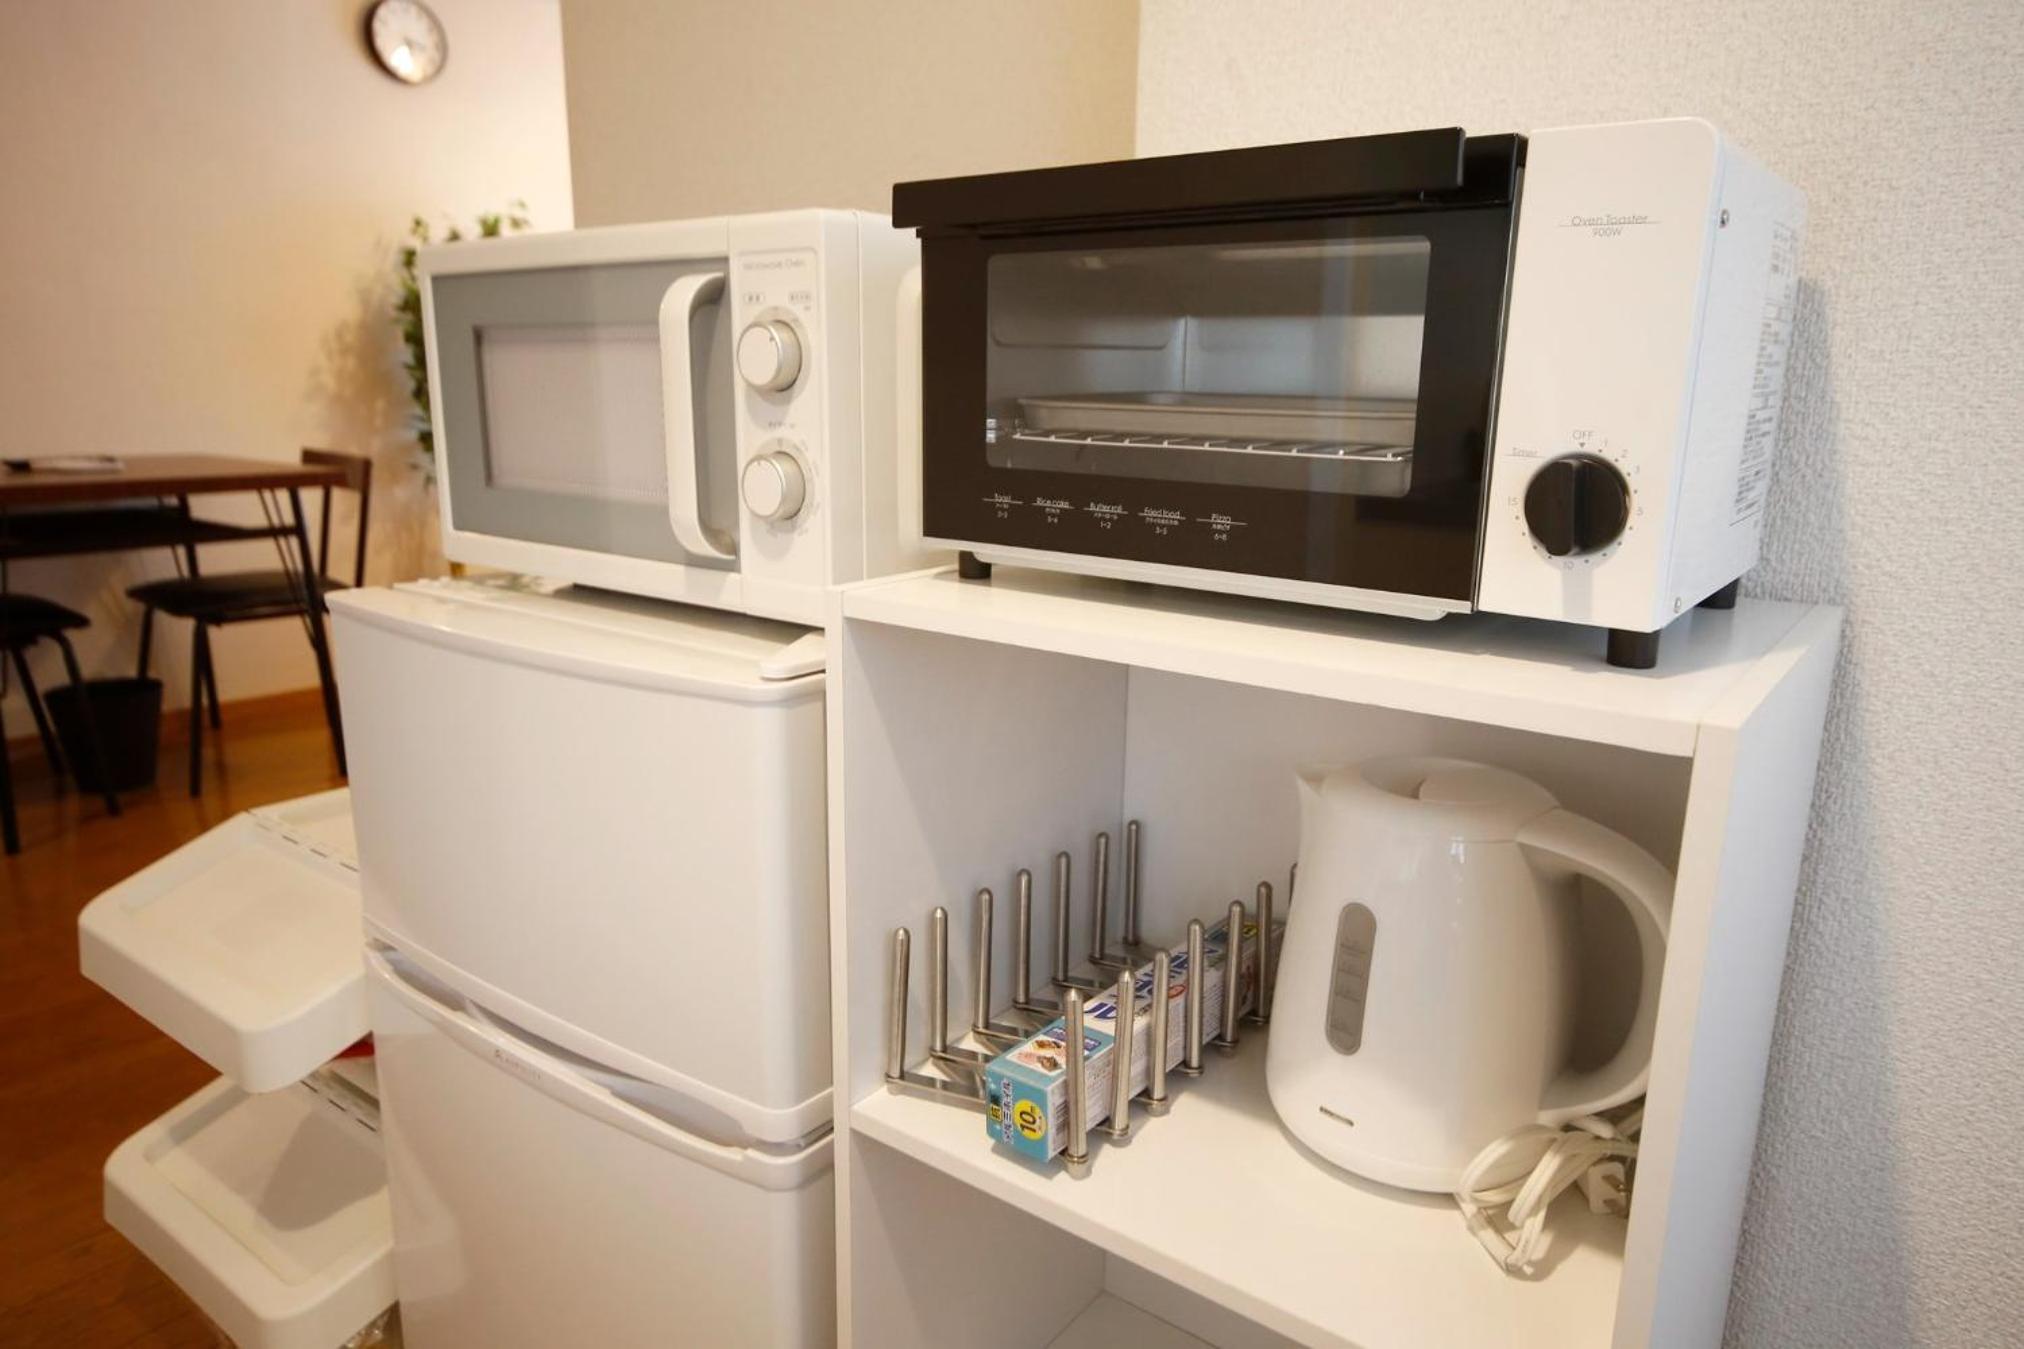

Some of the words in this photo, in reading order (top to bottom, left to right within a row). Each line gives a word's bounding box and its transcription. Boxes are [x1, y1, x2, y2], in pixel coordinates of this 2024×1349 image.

[1571, 215, 1603, 227] Oven
[1604, 213, 1648, 225] Toaster
[1572, 430, 1594, 440] OFF
